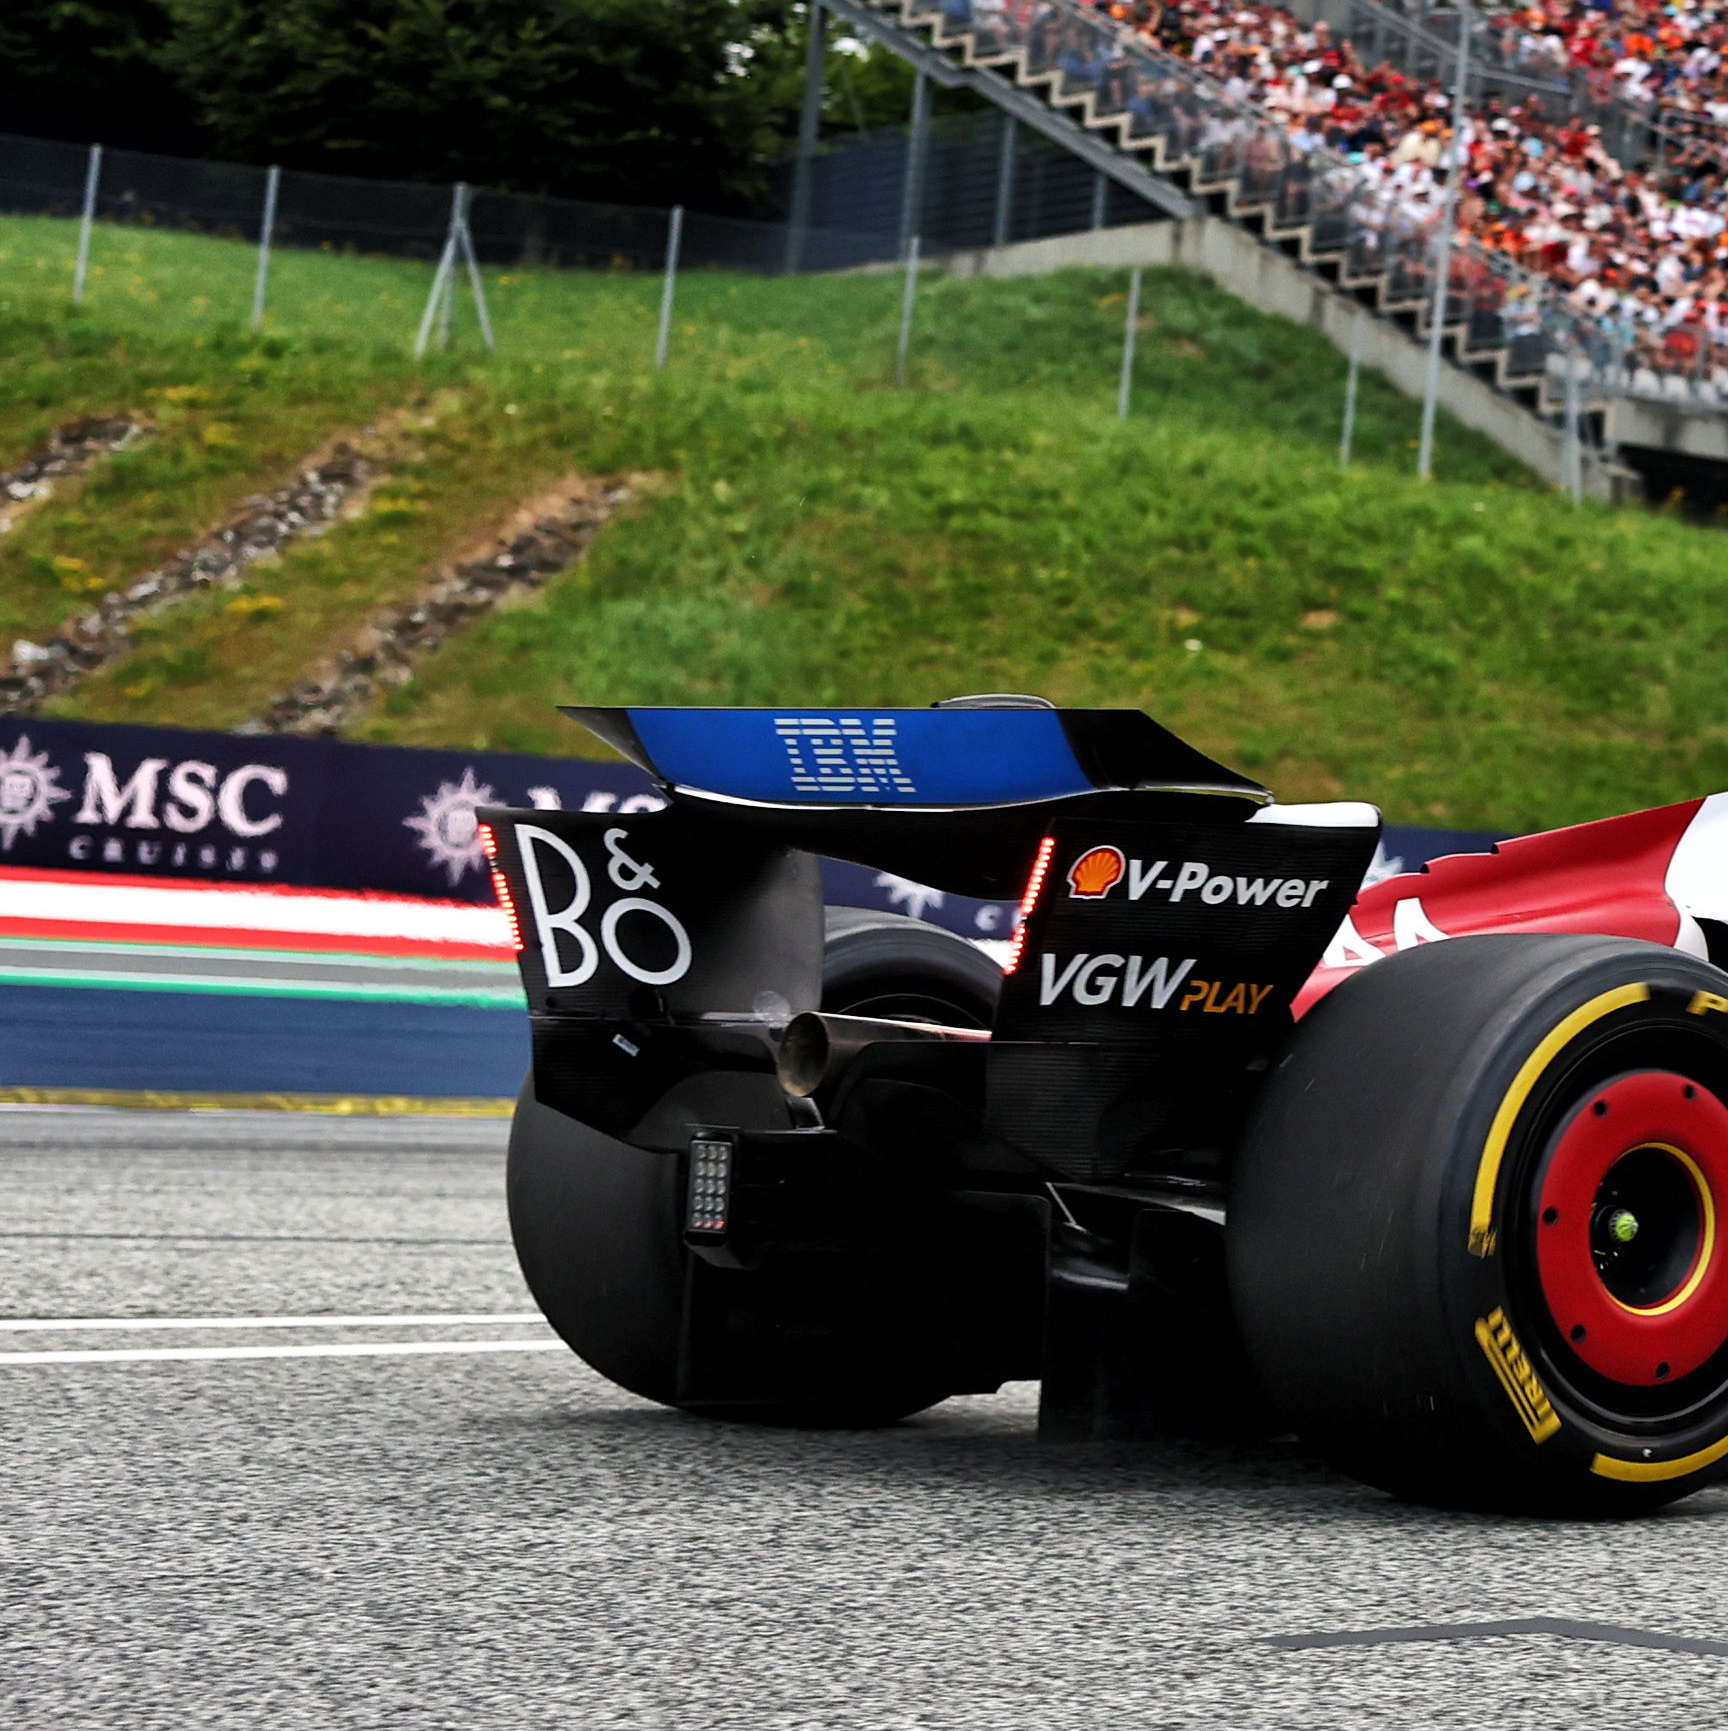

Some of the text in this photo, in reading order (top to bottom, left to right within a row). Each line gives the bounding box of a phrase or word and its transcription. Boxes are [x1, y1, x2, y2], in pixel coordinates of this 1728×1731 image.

[774, 718, 917, 793] IBM
[74, 751, 289, 838] MSC
[1127, 858, 1330, 908] V-Power
[1039, 952, 1275, 1014] VGW PLAY
